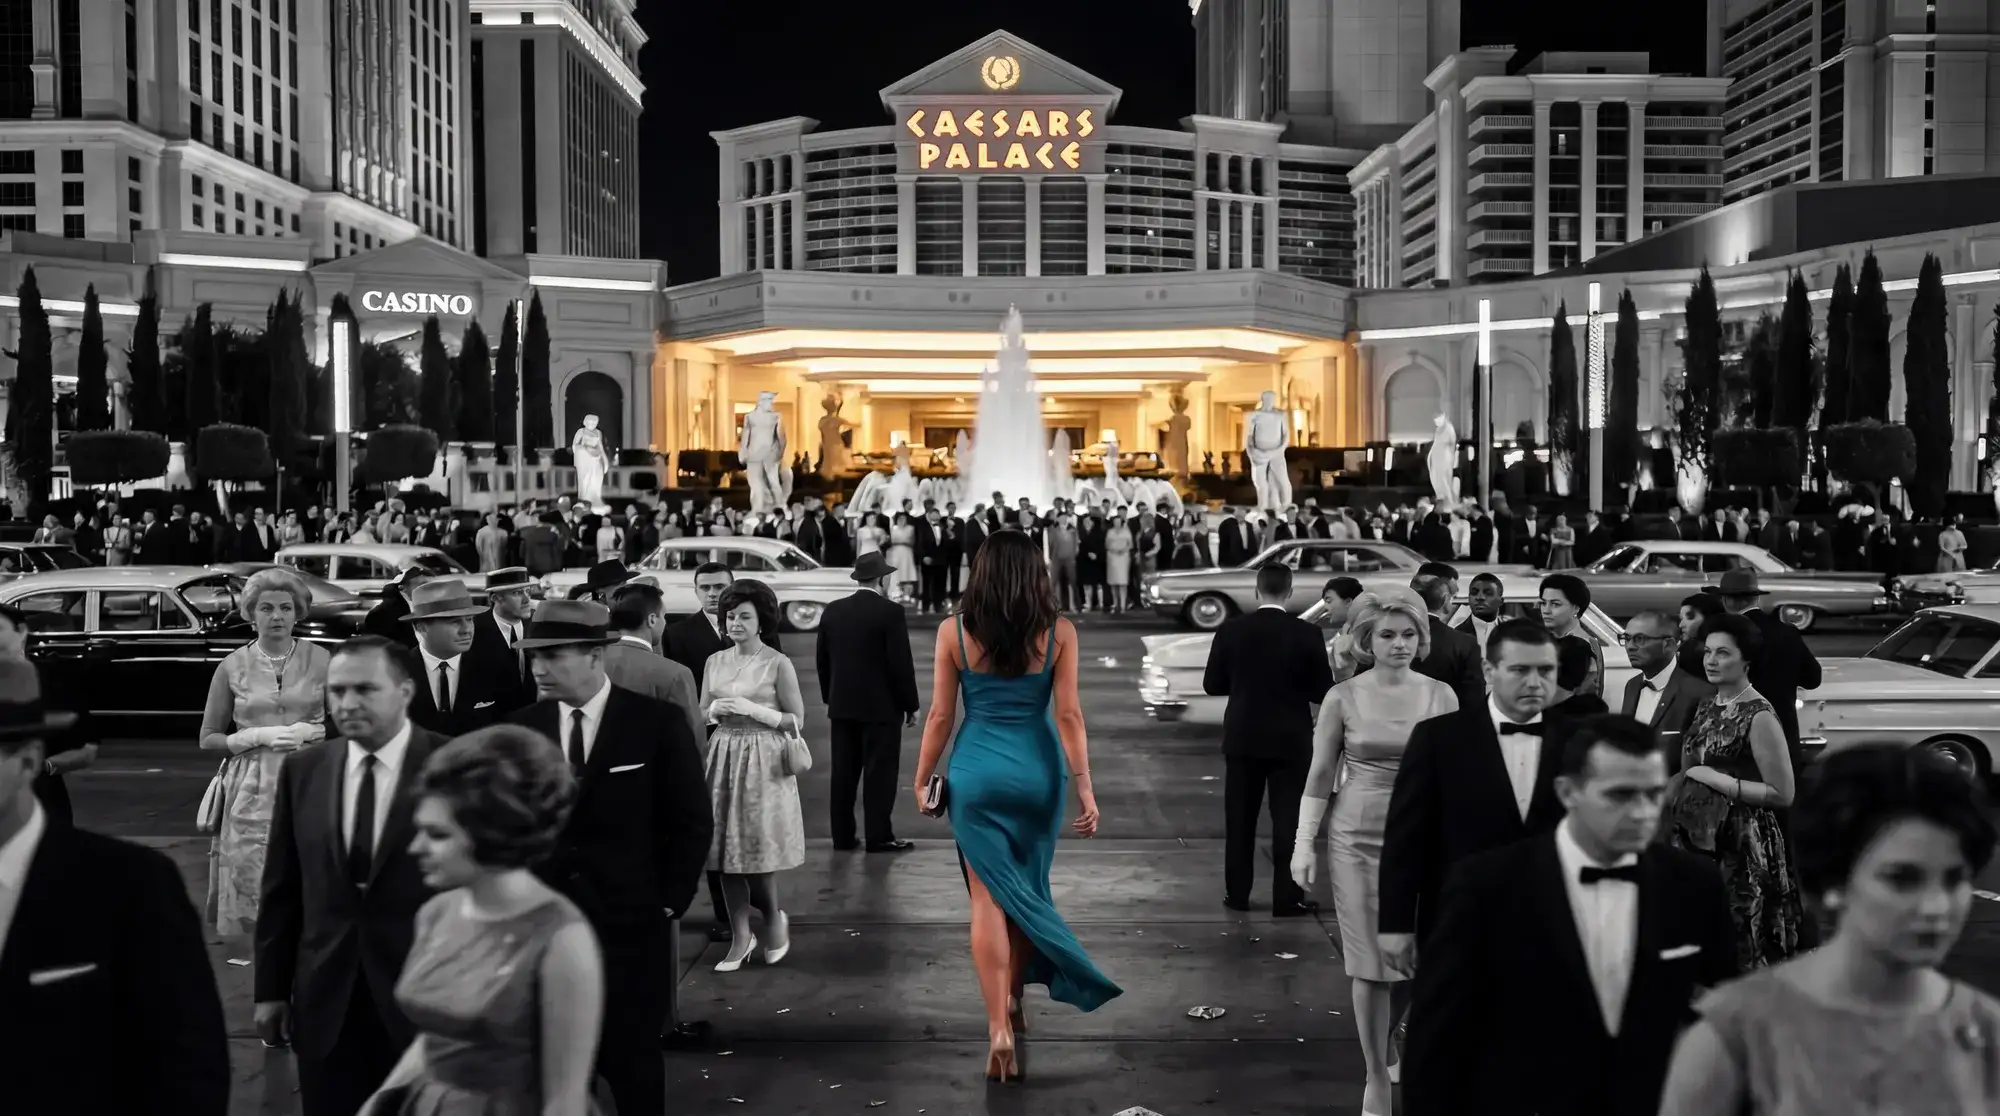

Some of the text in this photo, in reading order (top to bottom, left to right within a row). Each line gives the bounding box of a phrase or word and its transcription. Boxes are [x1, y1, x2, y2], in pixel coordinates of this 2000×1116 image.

[906, 109, 1094, 138] CAESARS
[919, 141, 1080, 169] PALACE
[362, 290, 473, 315] CASINO
